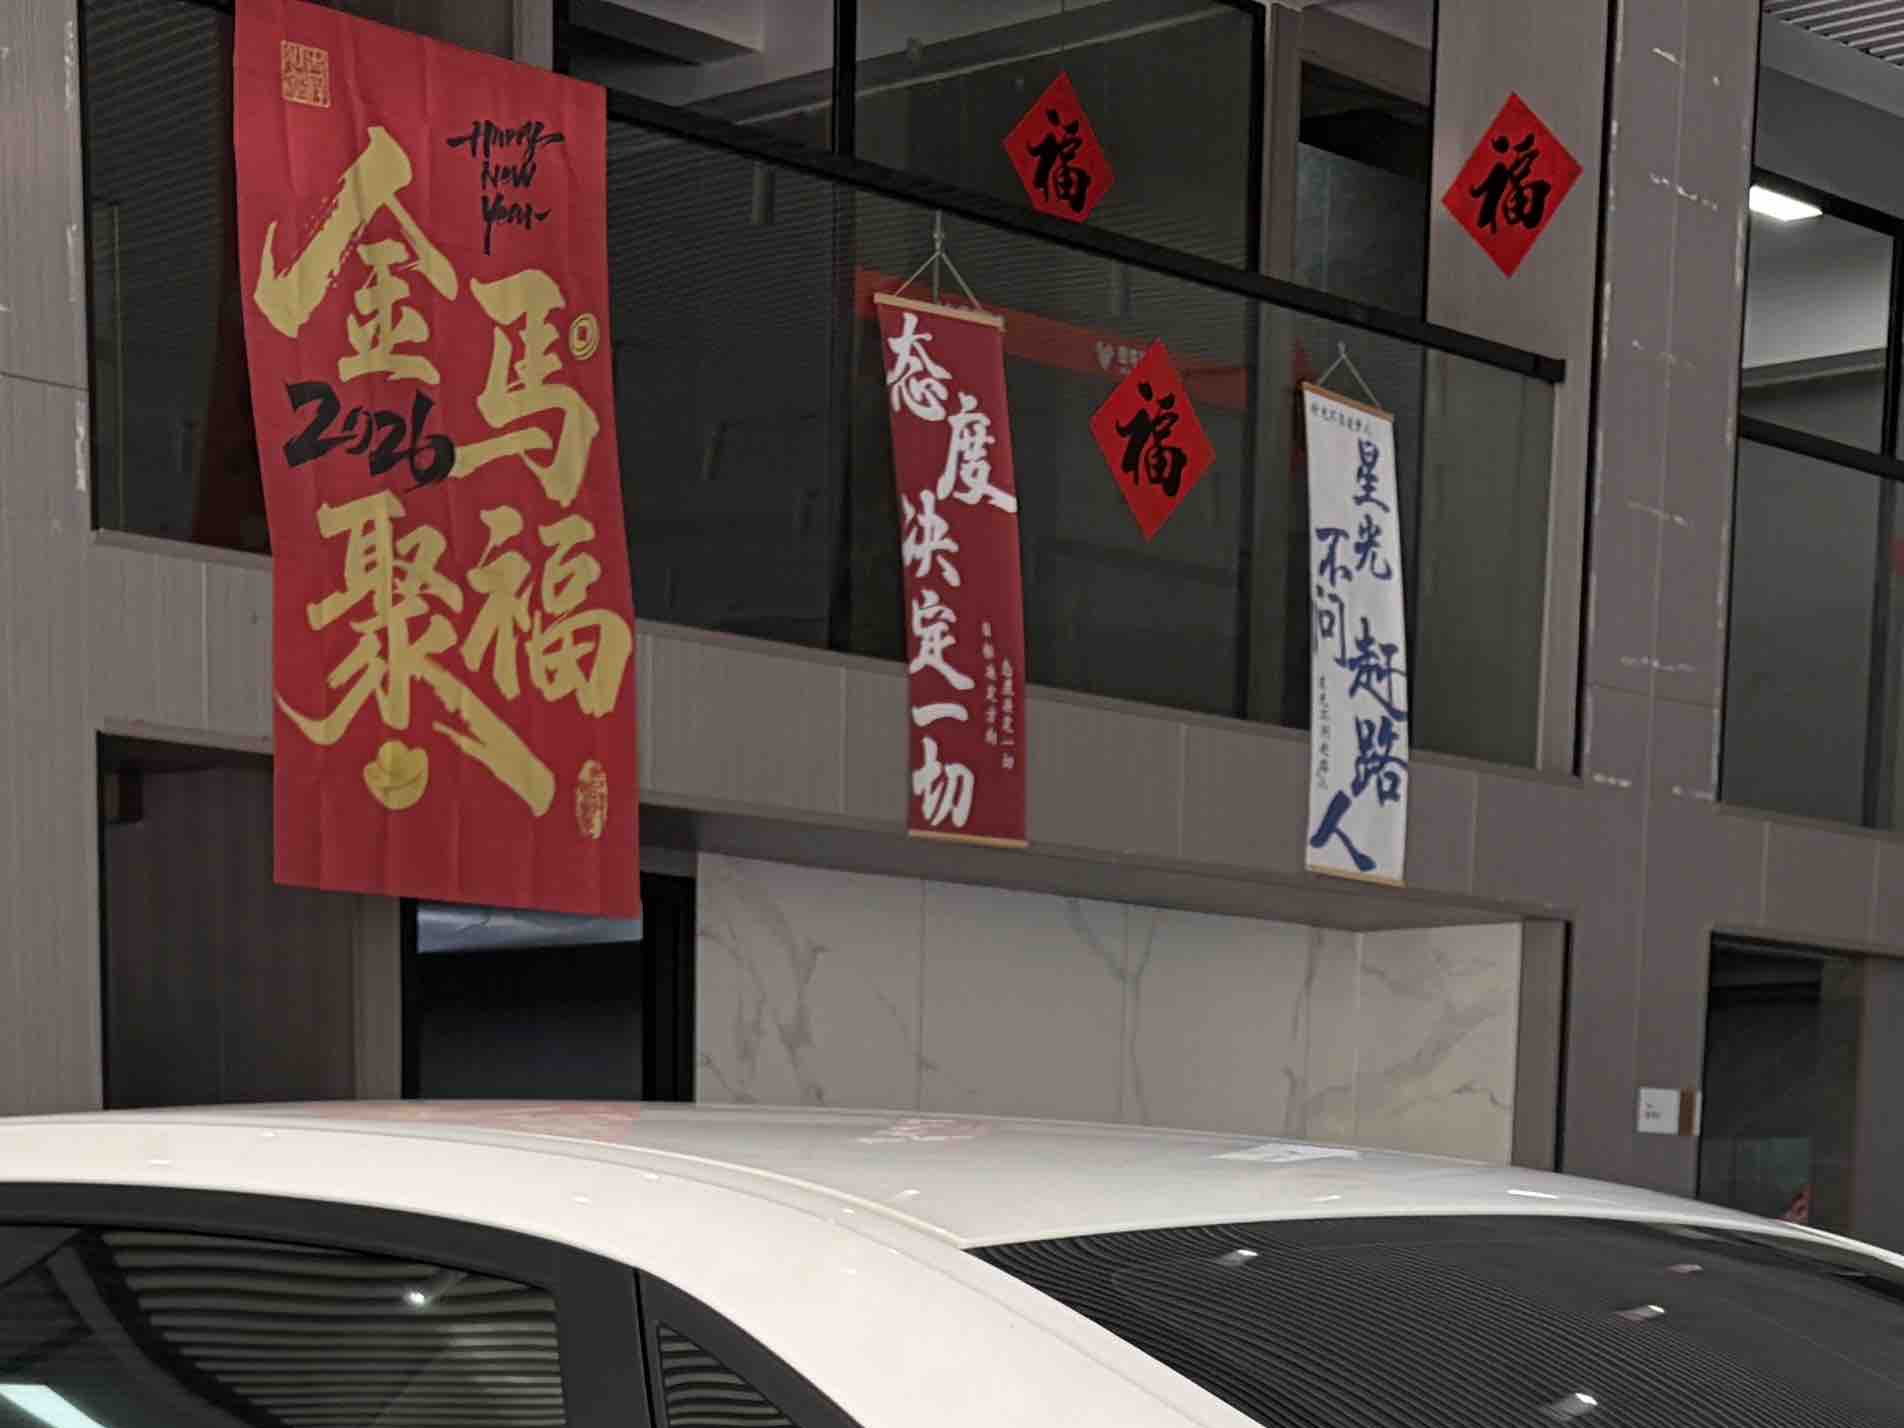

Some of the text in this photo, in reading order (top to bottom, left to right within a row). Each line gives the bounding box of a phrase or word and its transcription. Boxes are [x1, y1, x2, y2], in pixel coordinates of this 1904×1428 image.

[1027, 109, 1092, 213] 福
[1469, 133, 1554, 235] 福
[284, 381, 455, 492] 2026
[1115, 382, 1186, 497] 福
